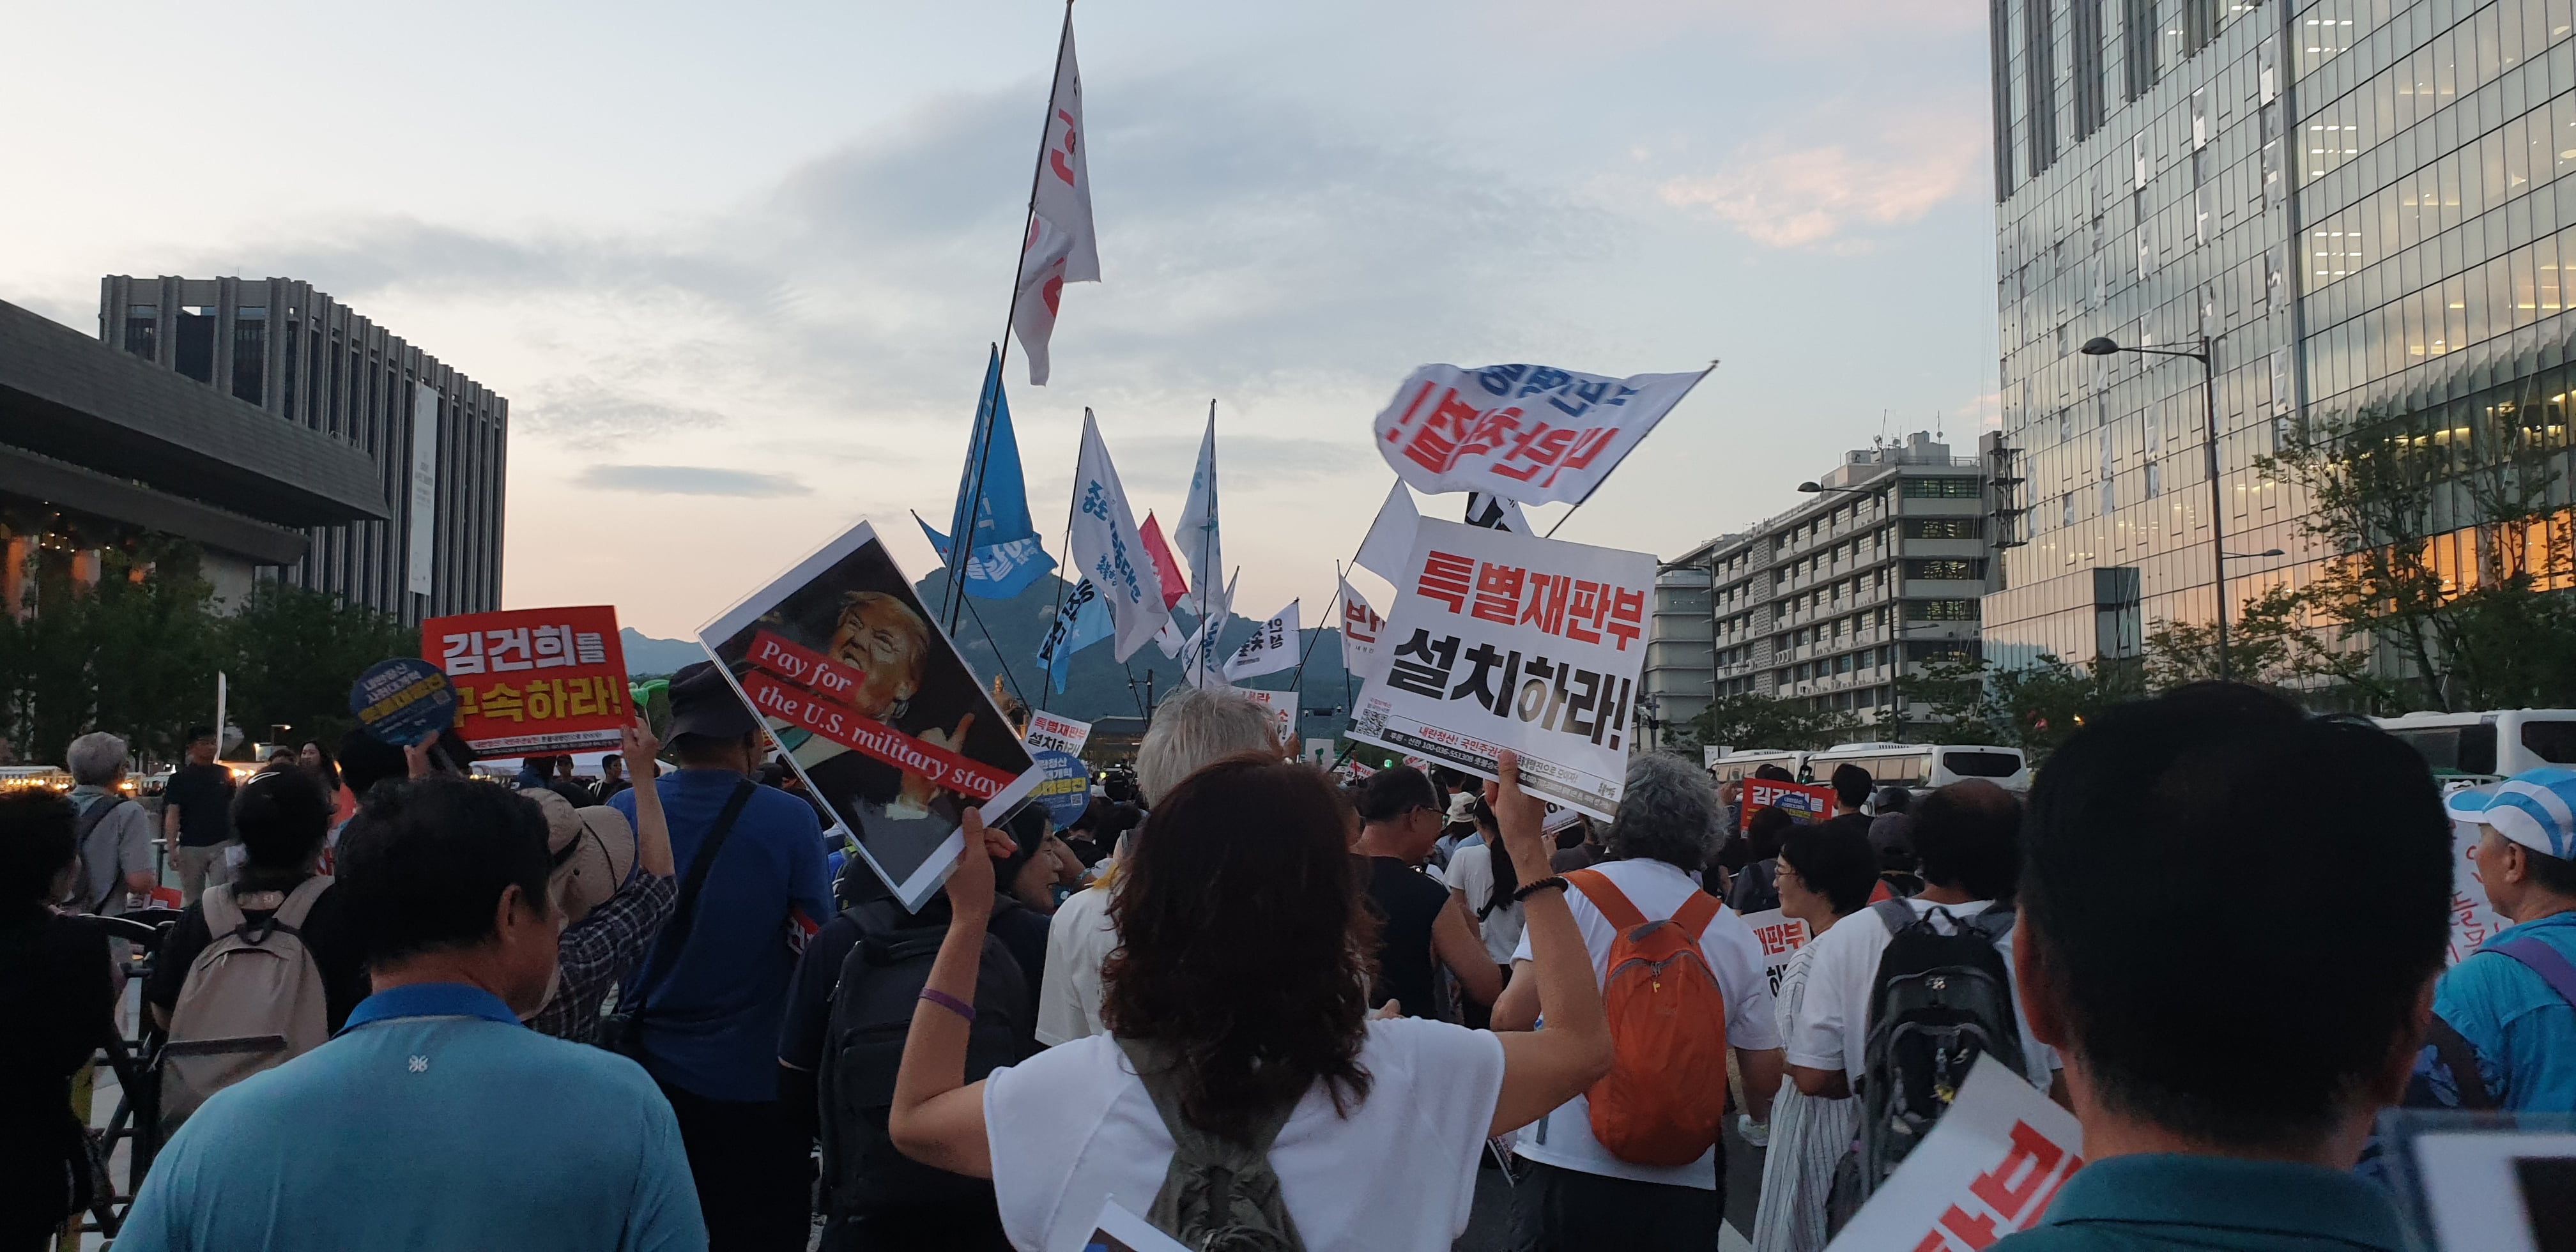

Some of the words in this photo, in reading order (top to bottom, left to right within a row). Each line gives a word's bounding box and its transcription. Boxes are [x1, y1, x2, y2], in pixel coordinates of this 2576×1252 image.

[1417, 550, 1644, 652] 특별재판부
[443, 625, 607, 676] 김건희를
[759, 640, 808, 676] Pay
[811, 662, 852, 692] for
[453, 676, 624, 728] 구속하라!
[1386, 628, 1630, 751] 설치하라!
[757, 685, 799, 716] the
[804, 702, 845, 737] U.S.
[852, 727, 949, 781] military
[951, 767, 1005, 801] stay
[1034, 716, 1087, 740] 특별재판부
[1408, 737, 1422, 747] 신한
[1419, 726, 1459, 745] 내란청산!
[1460, 737, 1517, 761] 국민주권
